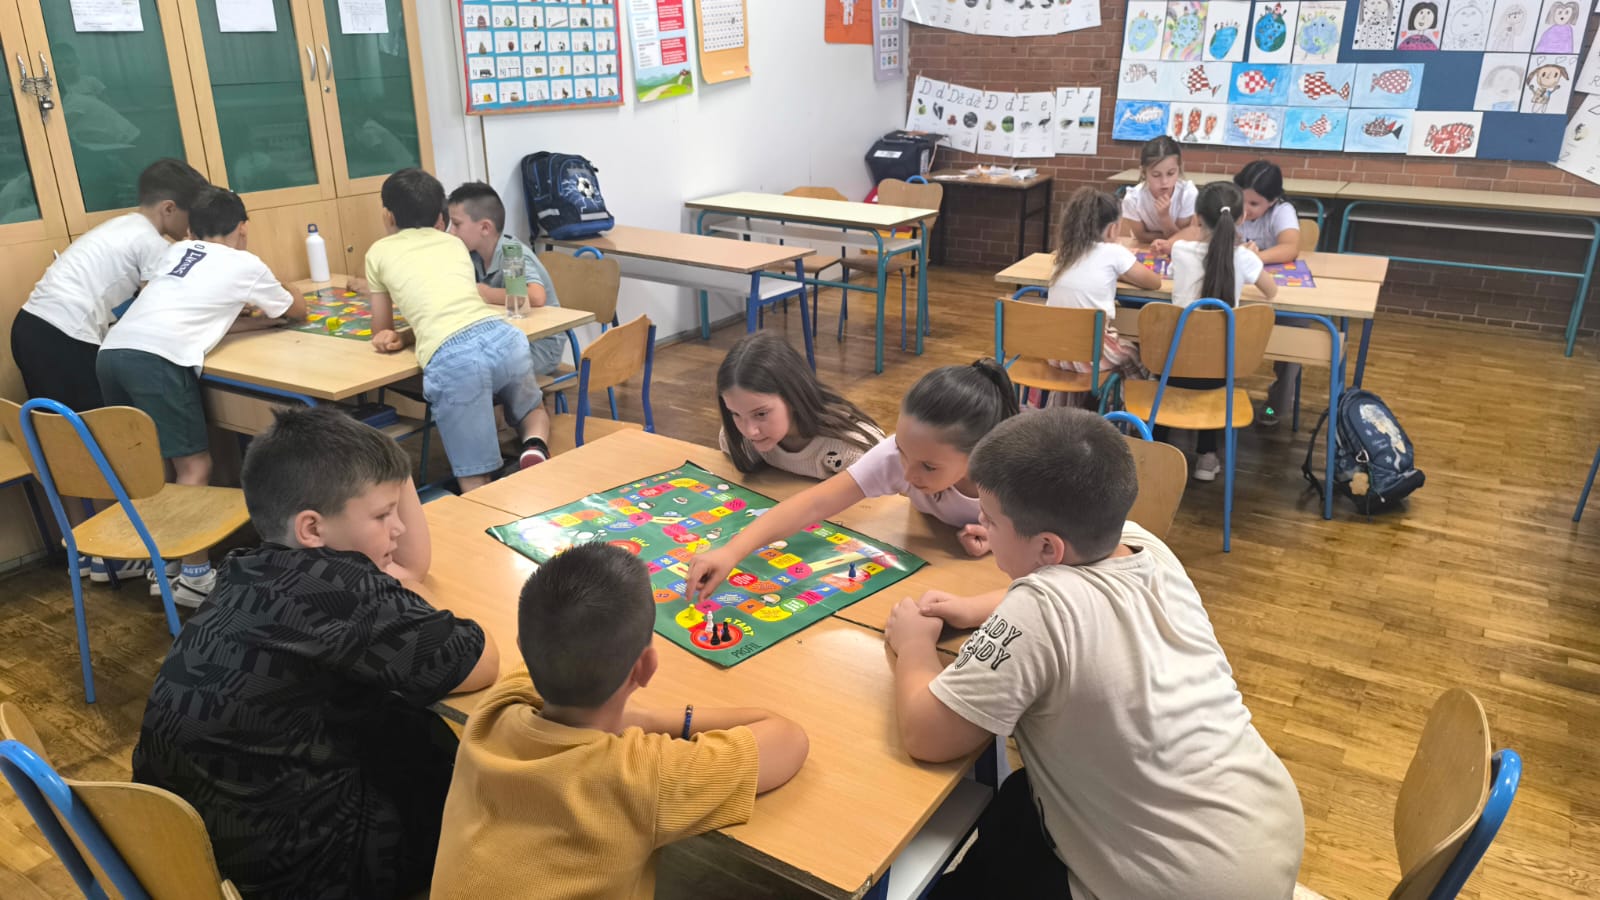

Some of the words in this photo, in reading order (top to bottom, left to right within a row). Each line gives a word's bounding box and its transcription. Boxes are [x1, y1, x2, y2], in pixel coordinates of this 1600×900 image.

[919, 80, 932, 95] D
[936, 84, 946, 99] d
[1019, 95, 1032, 112] E
[1040, 100, 1047, 111] e
[1061, 90, 1075, 107] F
[724, 617, 754, 636] START
[731, 642, 762, 659] PROFIL
